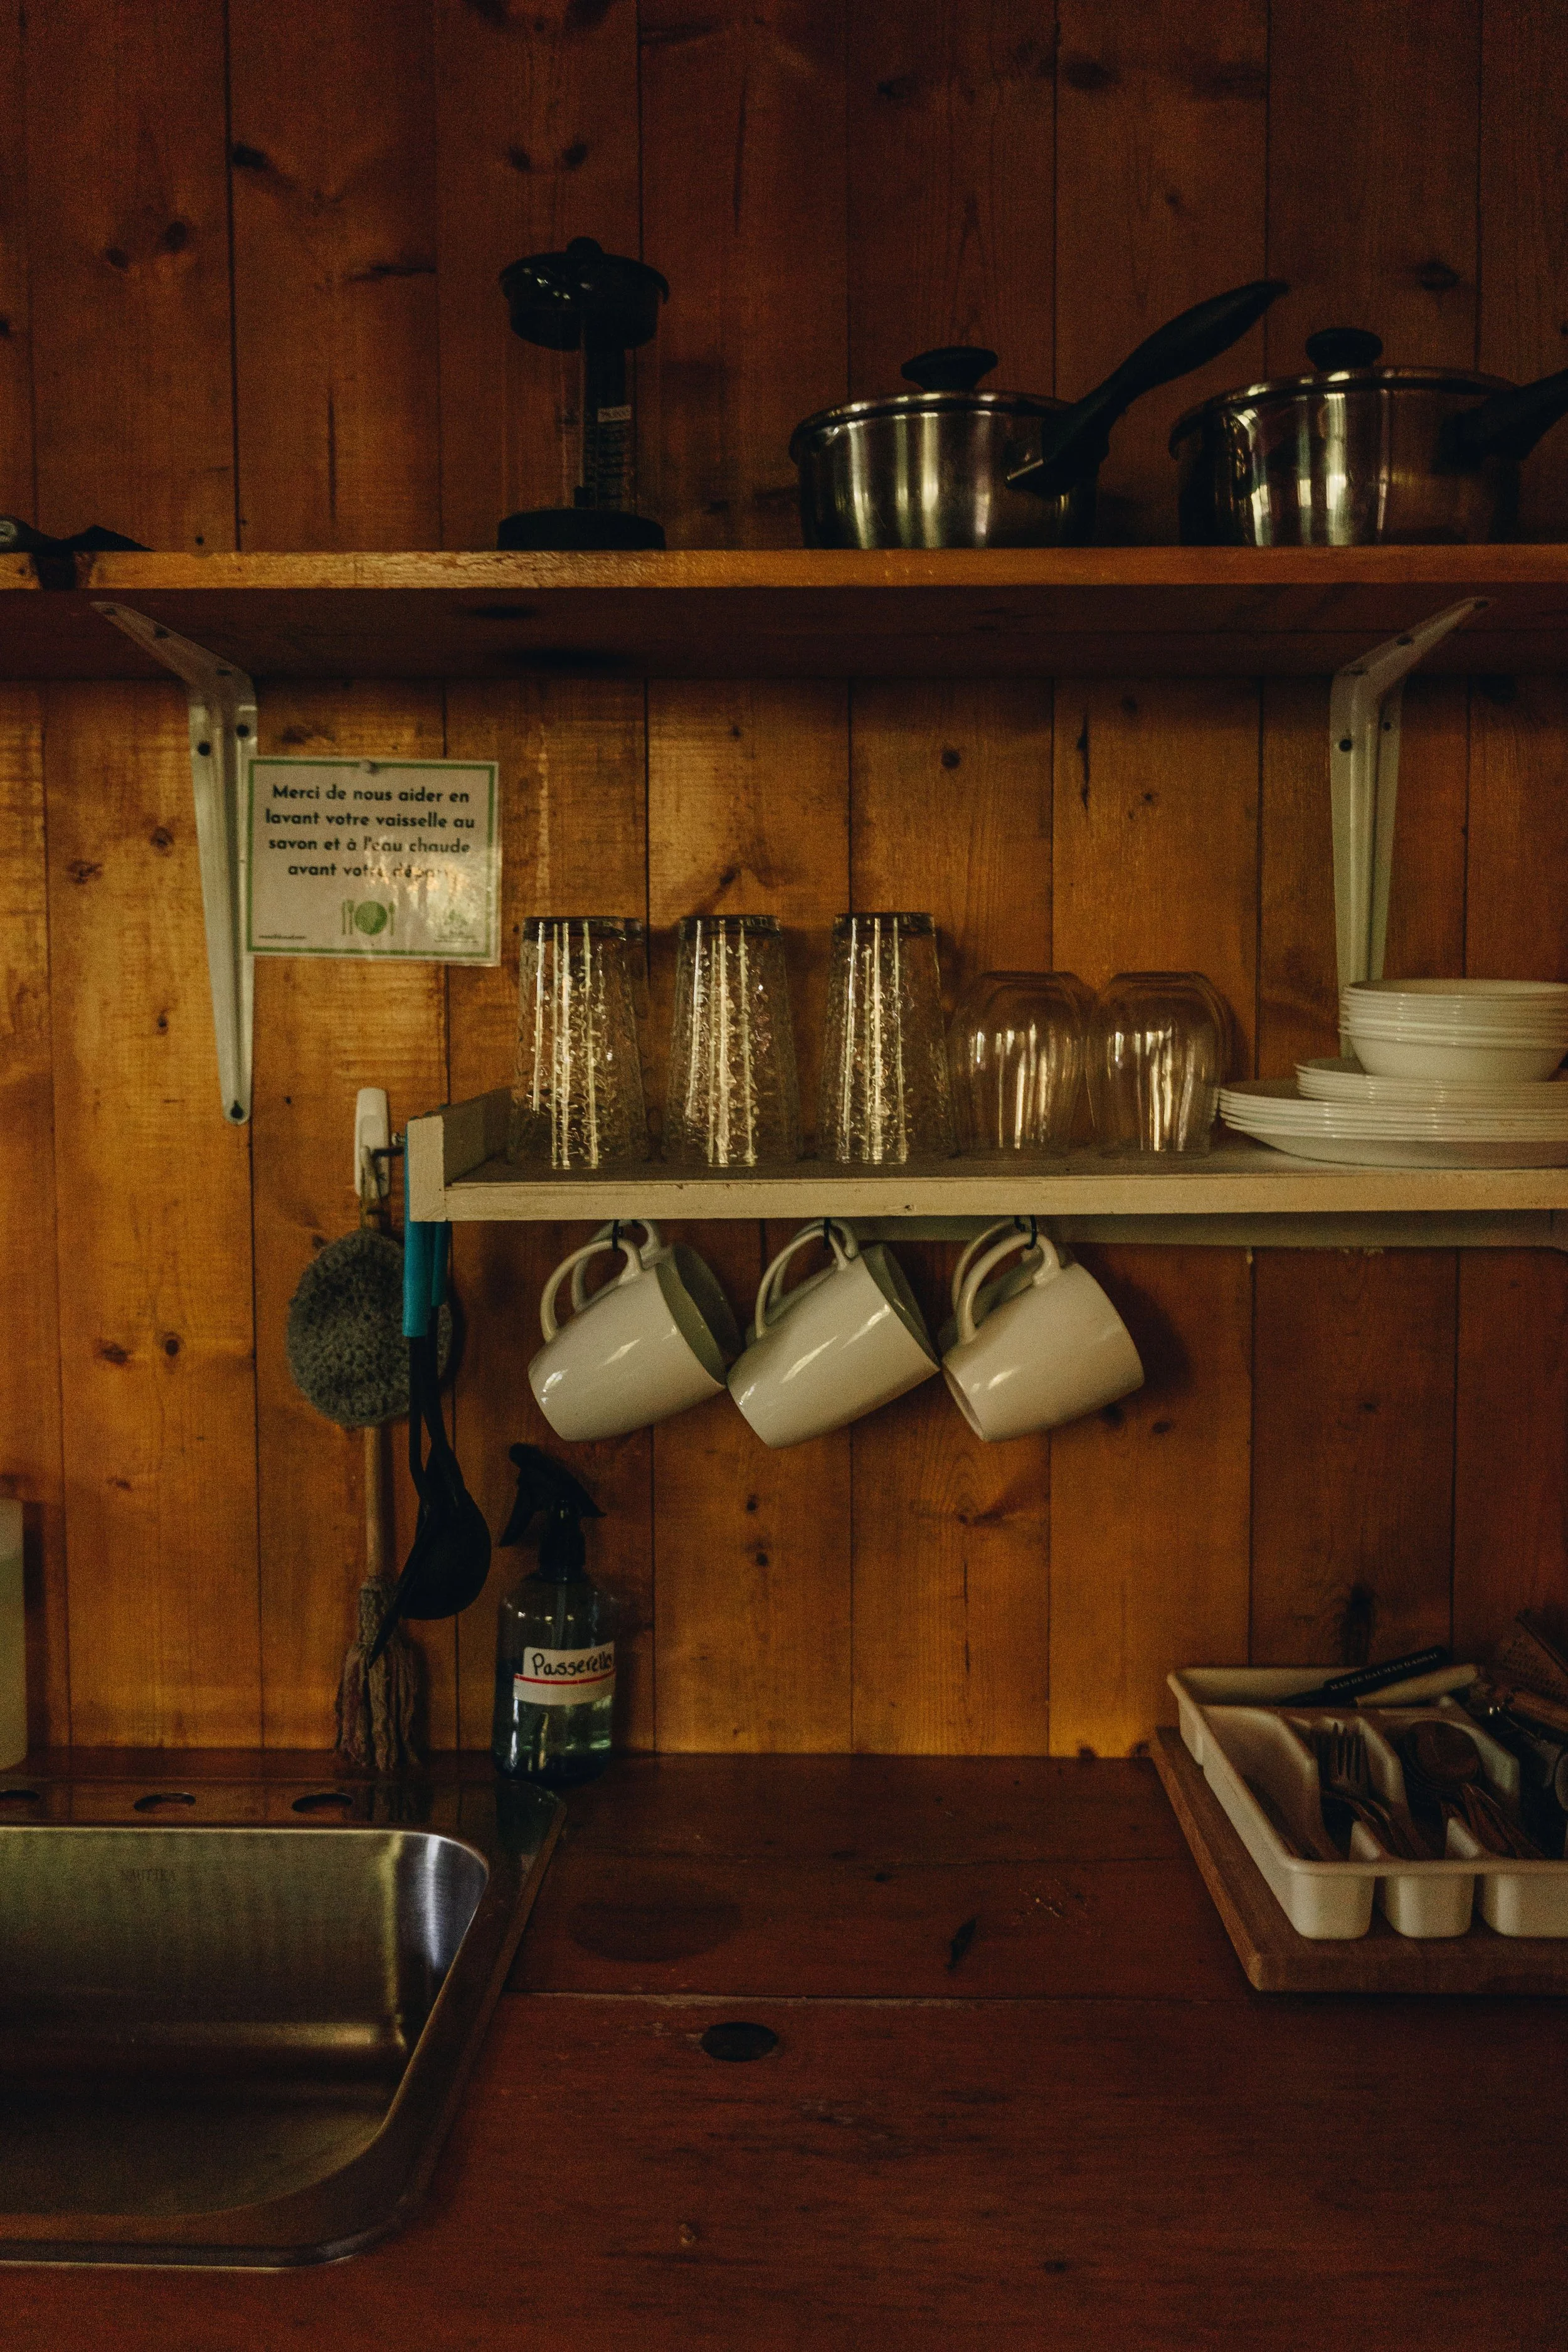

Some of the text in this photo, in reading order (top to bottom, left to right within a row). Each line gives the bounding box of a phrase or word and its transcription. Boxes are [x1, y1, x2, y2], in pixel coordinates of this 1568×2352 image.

[272, 784, 470, 803] Merci de nous aider en
[265, 808, 475, 829] lavant votre vaisselle au
[268, 835, 470, 853] savon et à l'eau chaude
[288, 863, 337, 876] avant
